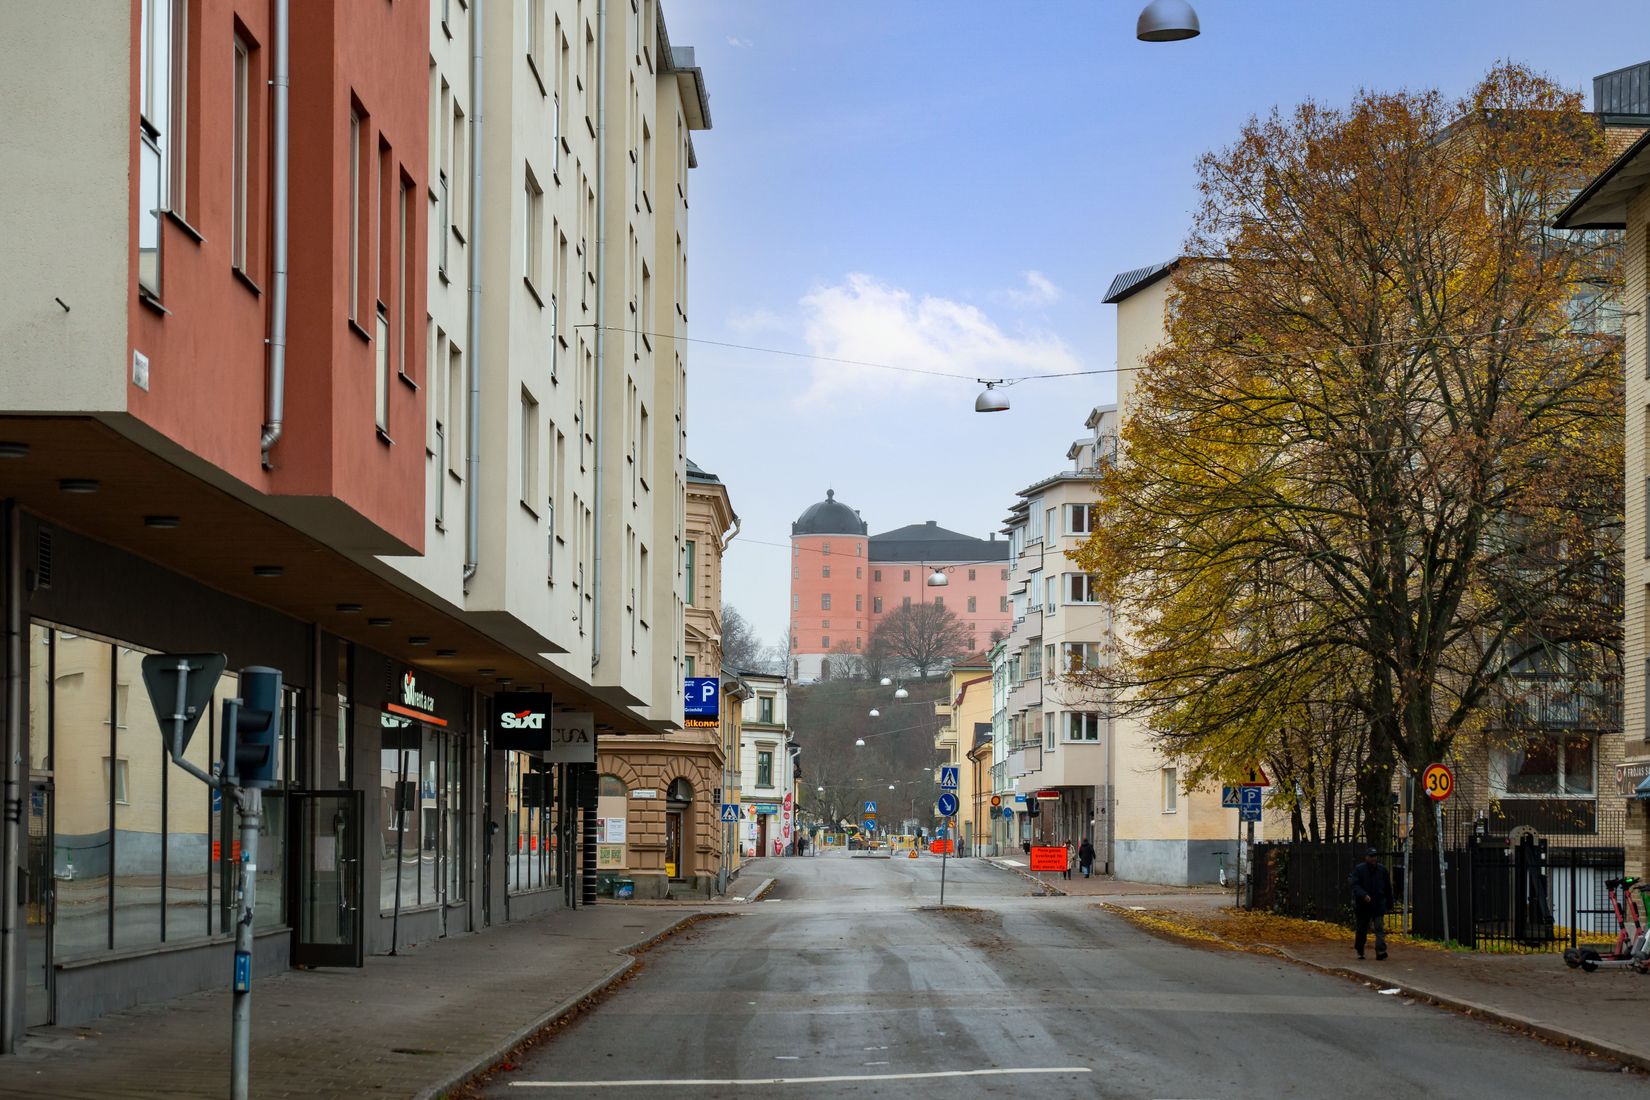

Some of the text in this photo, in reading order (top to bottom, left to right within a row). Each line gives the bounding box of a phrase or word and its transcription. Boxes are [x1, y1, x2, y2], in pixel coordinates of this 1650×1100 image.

[702, 686, 714, 702] P
[1429, 773, 1449, 791] 30
[1248, 791, 1256, 804] P
